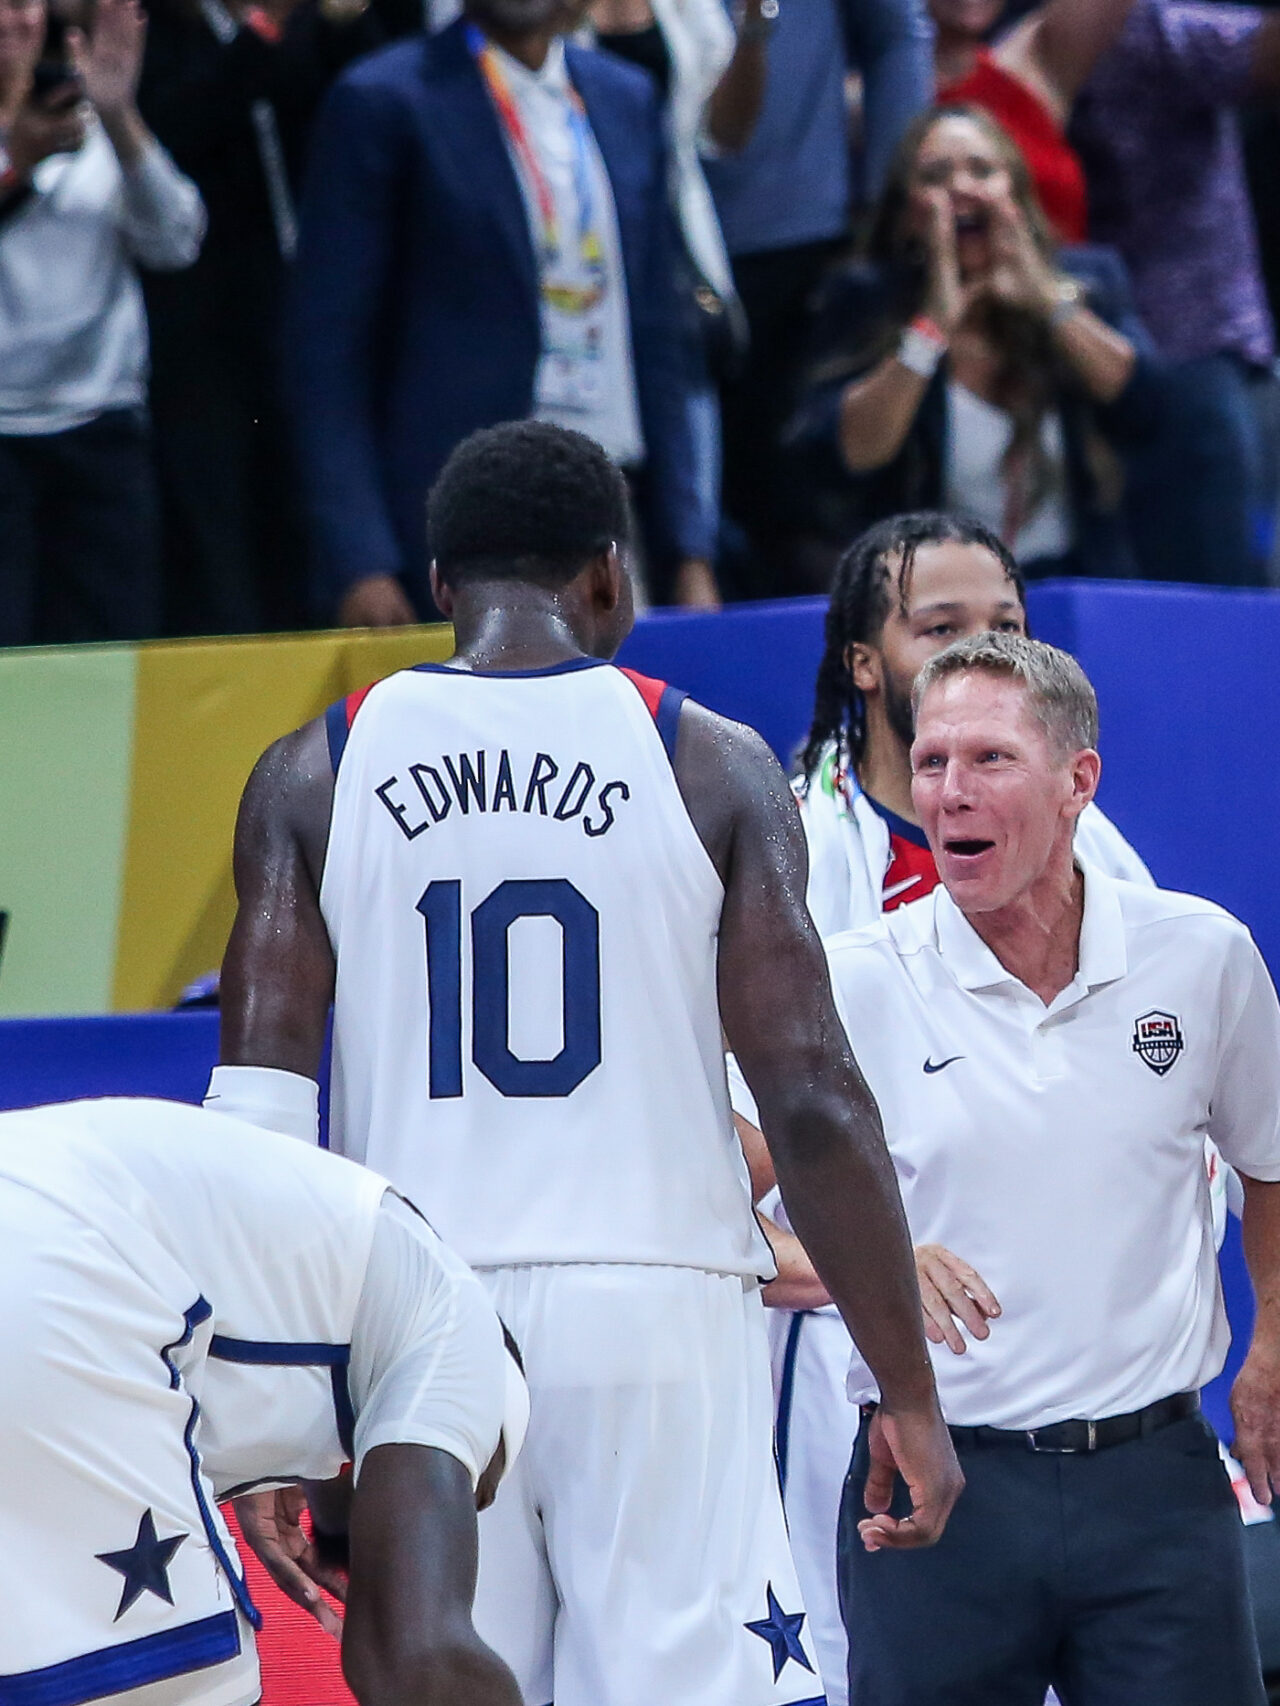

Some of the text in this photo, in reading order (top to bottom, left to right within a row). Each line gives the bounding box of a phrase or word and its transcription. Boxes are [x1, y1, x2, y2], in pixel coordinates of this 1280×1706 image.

[375, 749, 630, 841] EDWARDS
[415, 878, 602, 1100] 10
[1141, 1021, 1174, 1038] USA
